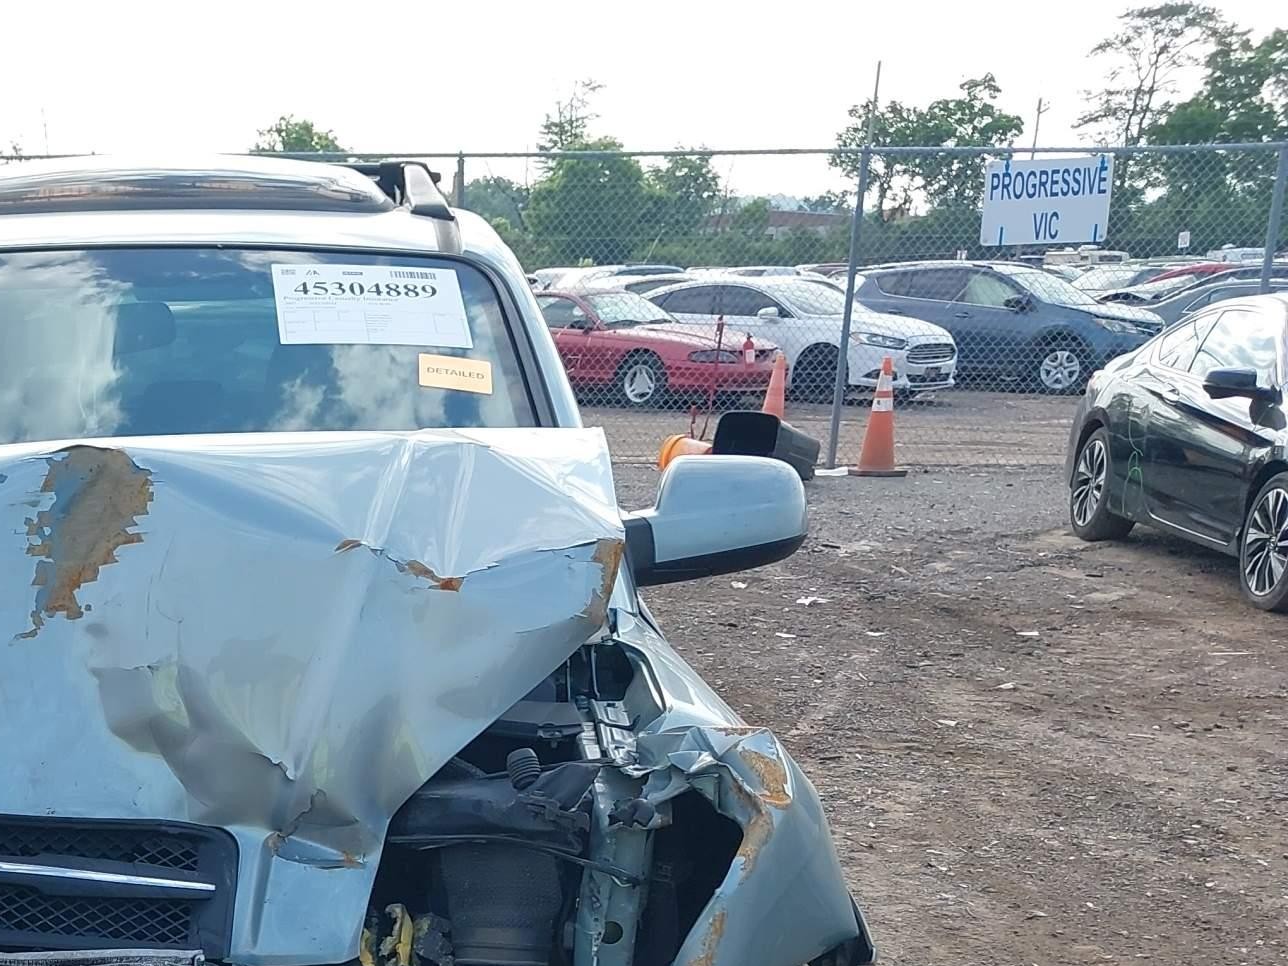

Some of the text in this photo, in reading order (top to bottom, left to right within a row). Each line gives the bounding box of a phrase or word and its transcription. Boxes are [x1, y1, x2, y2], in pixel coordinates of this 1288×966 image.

[990, 166, 1108, 200] PROGRESSIVE
[1033, 211, 1059, 240] VIC
[294, 281, 437, 298] 45304889
[426, 366, 485, 380] DETAILED
